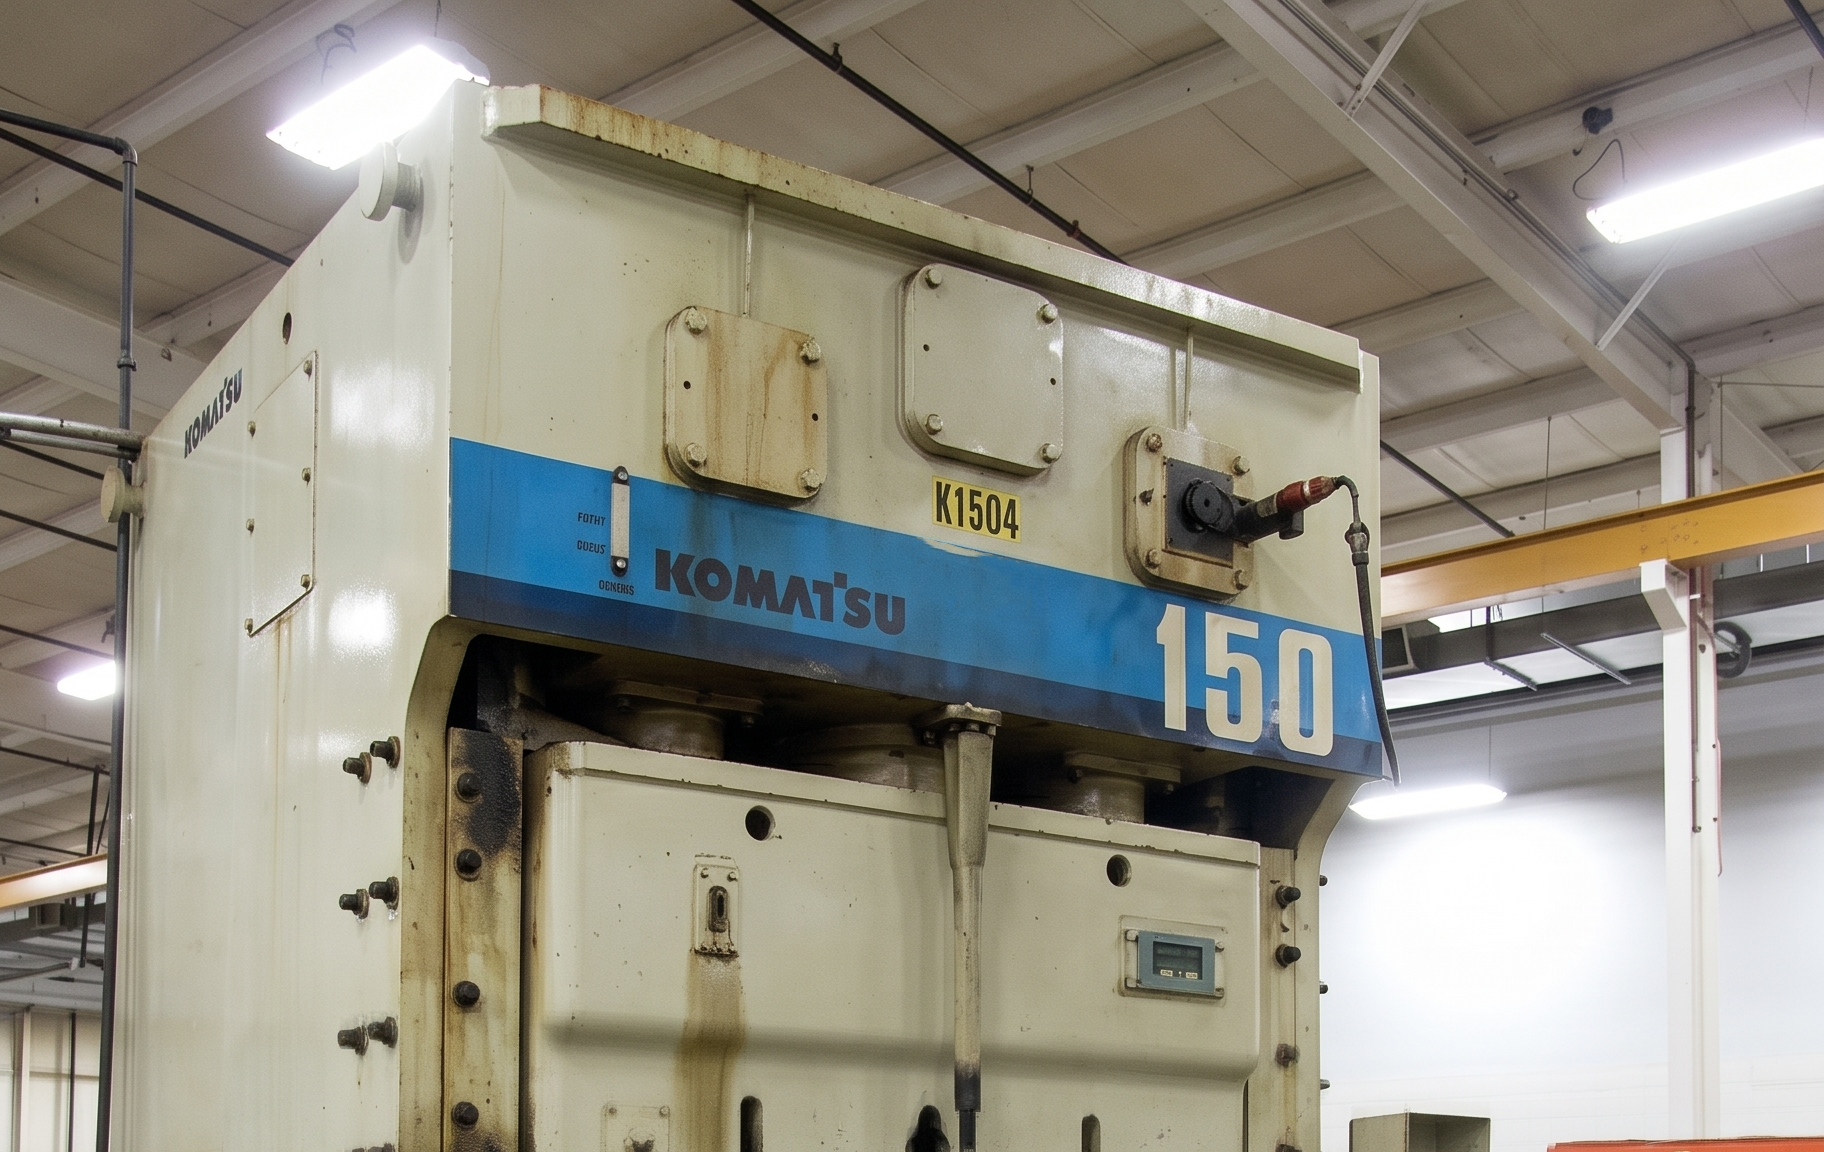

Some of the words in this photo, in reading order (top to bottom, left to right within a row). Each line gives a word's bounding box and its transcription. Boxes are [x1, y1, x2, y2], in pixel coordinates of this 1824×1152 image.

[936, 481, 1019, 539] K1504
[655, 548, 906, 636] KOMATSU
[1156, 603, 1334, 757] 150
